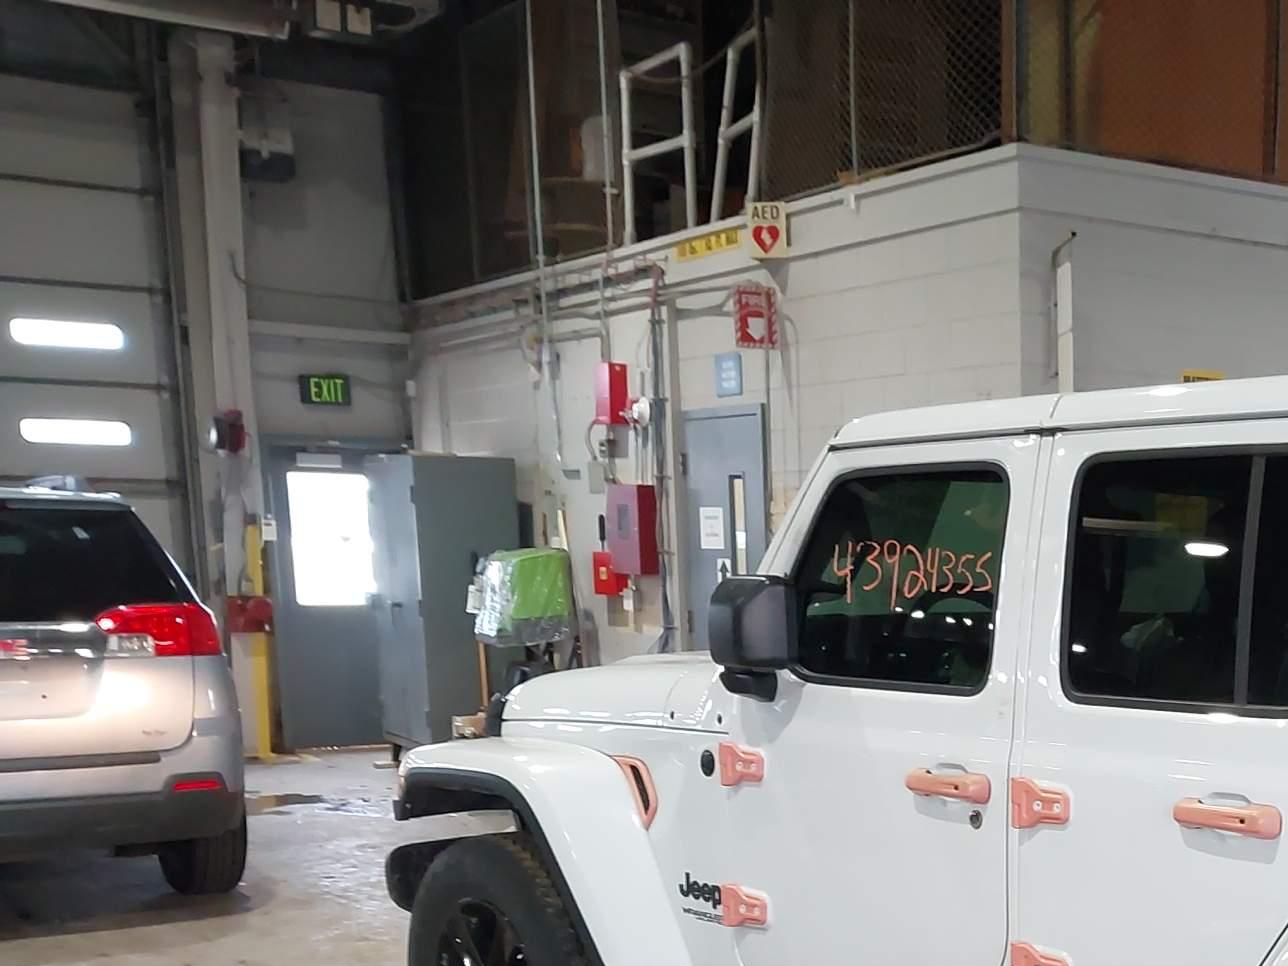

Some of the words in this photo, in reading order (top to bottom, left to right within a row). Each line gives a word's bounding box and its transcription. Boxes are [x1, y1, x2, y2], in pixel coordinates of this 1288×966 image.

[751, 205, 780, 220] AED
[309, 377, 344, 403] EXIT
[834, 540, 993, 610] 43924355
[679, 871, 721, 910] Jeep
